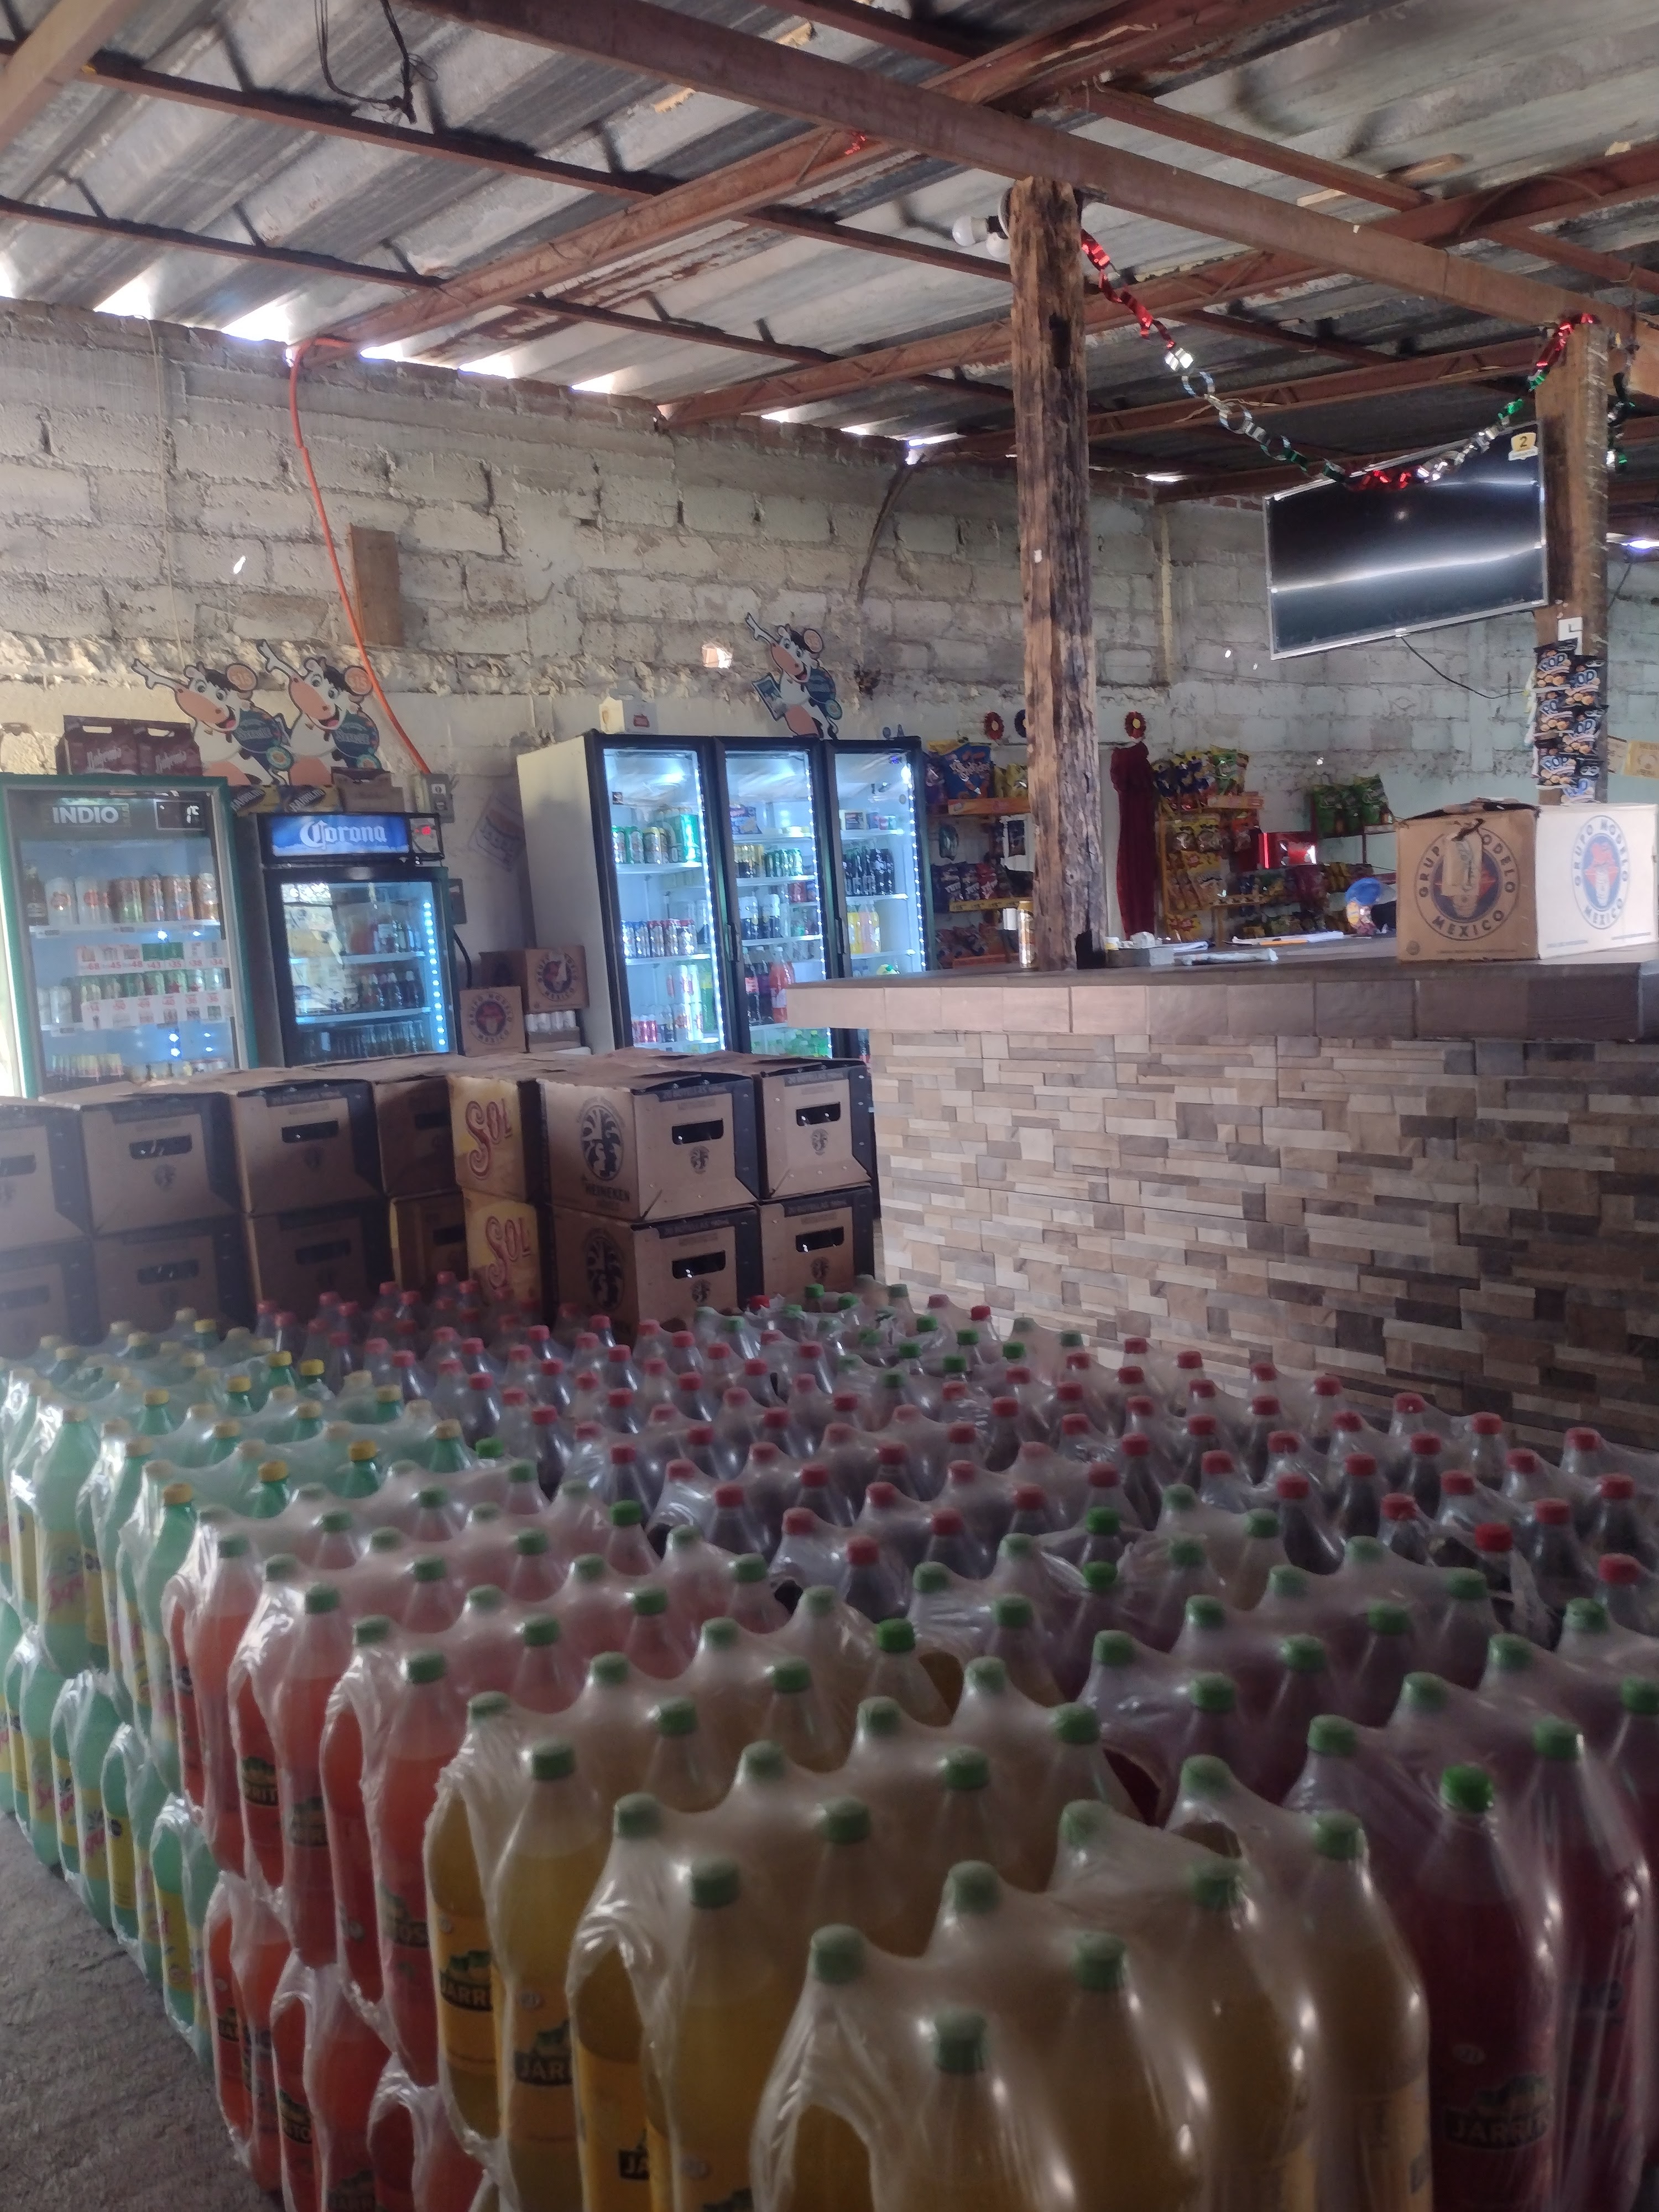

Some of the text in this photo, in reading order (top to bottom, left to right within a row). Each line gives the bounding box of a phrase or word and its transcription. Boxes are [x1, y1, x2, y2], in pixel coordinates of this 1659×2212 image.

[1519, 436, 1528, 448] 2
[52, 806, 119, 823] INDIO
[299, 820, 388, 850] Corona
[1419, 834, 1516, 898] GRUP ODELO
[1573, 818, 1628, 886] GRUPO MODELO
[1432, 910, 1505, 937] MEXICO
[1584, 898, 1623, 925] MEXICO
[465, 1098, 513, 1181] SOL
[585, 1183, 630, 1202] HEINEKEN
[486, 1216, 532, 1292] SOL
